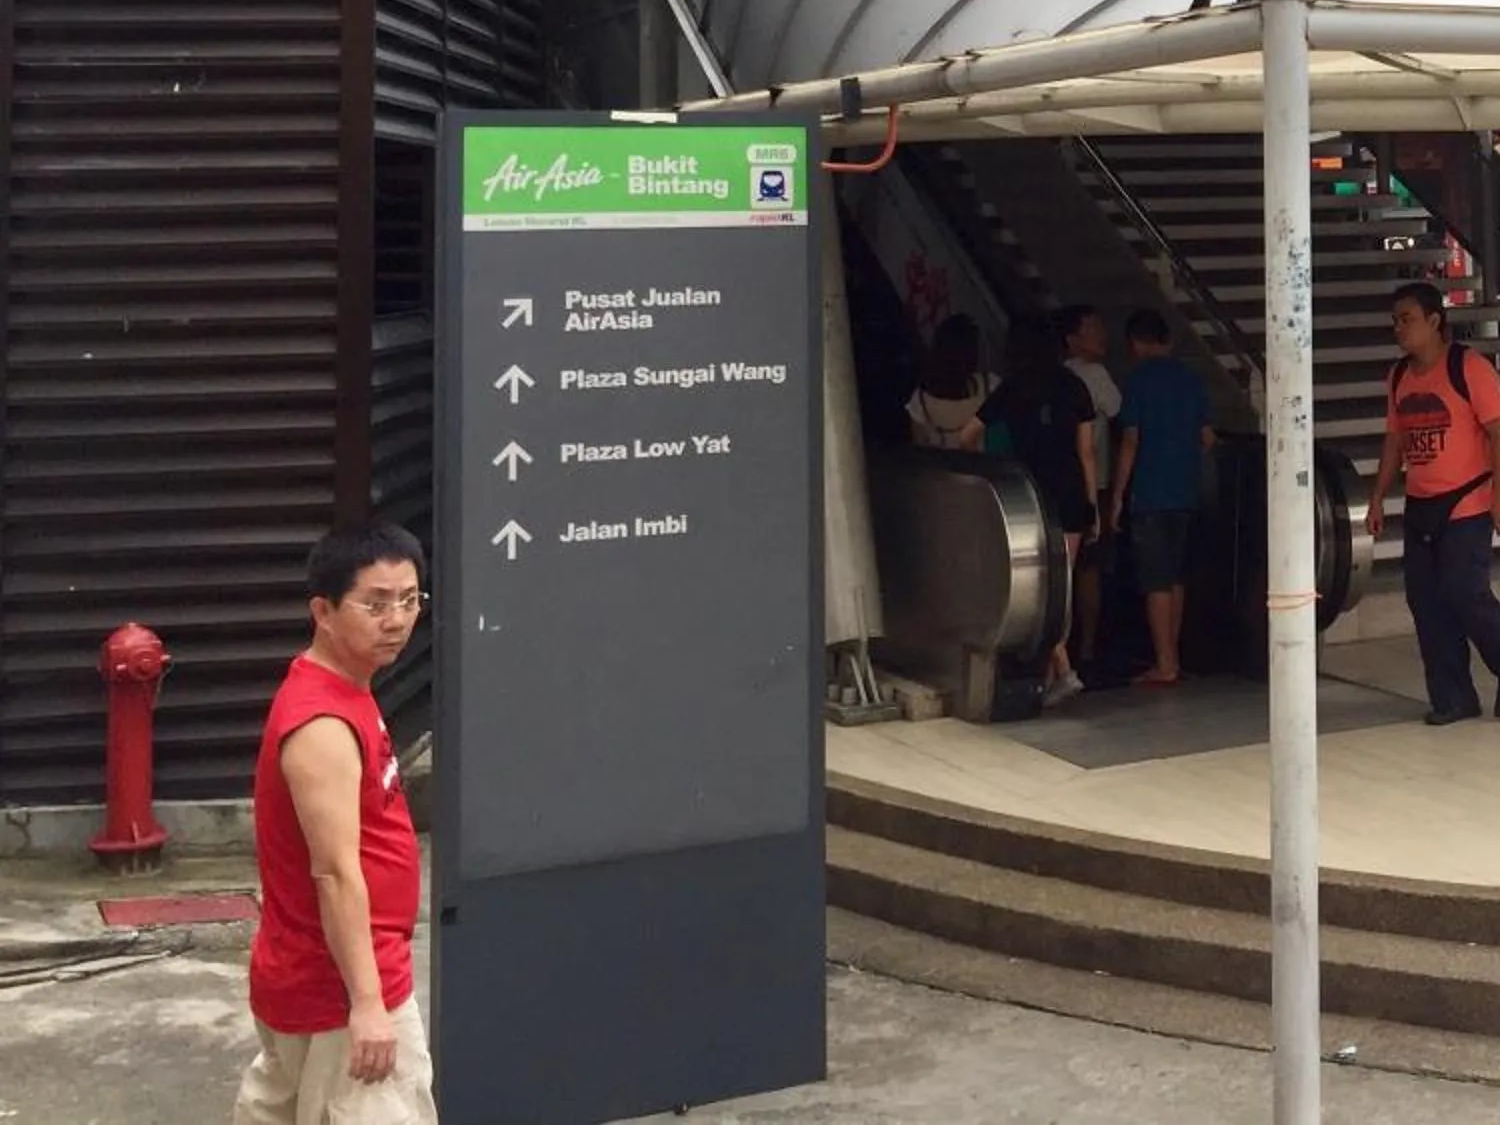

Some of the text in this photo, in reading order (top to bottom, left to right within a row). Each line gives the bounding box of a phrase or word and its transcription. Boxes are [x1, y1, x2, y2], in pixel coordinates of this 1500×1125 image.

[628, 155, 698, 175] Bukit
[628, 176, 729, 199] Bintang
[565, 286, 721, 310] Pusat Jualan
[564, 311, 653, 331] AirAsia
[560, 362, 786, 390] Plaza Sungai Wang
[560, 434, 731, 463] Plaza Low Yat
[559, 515, 688, 543] Jalan Imbi
